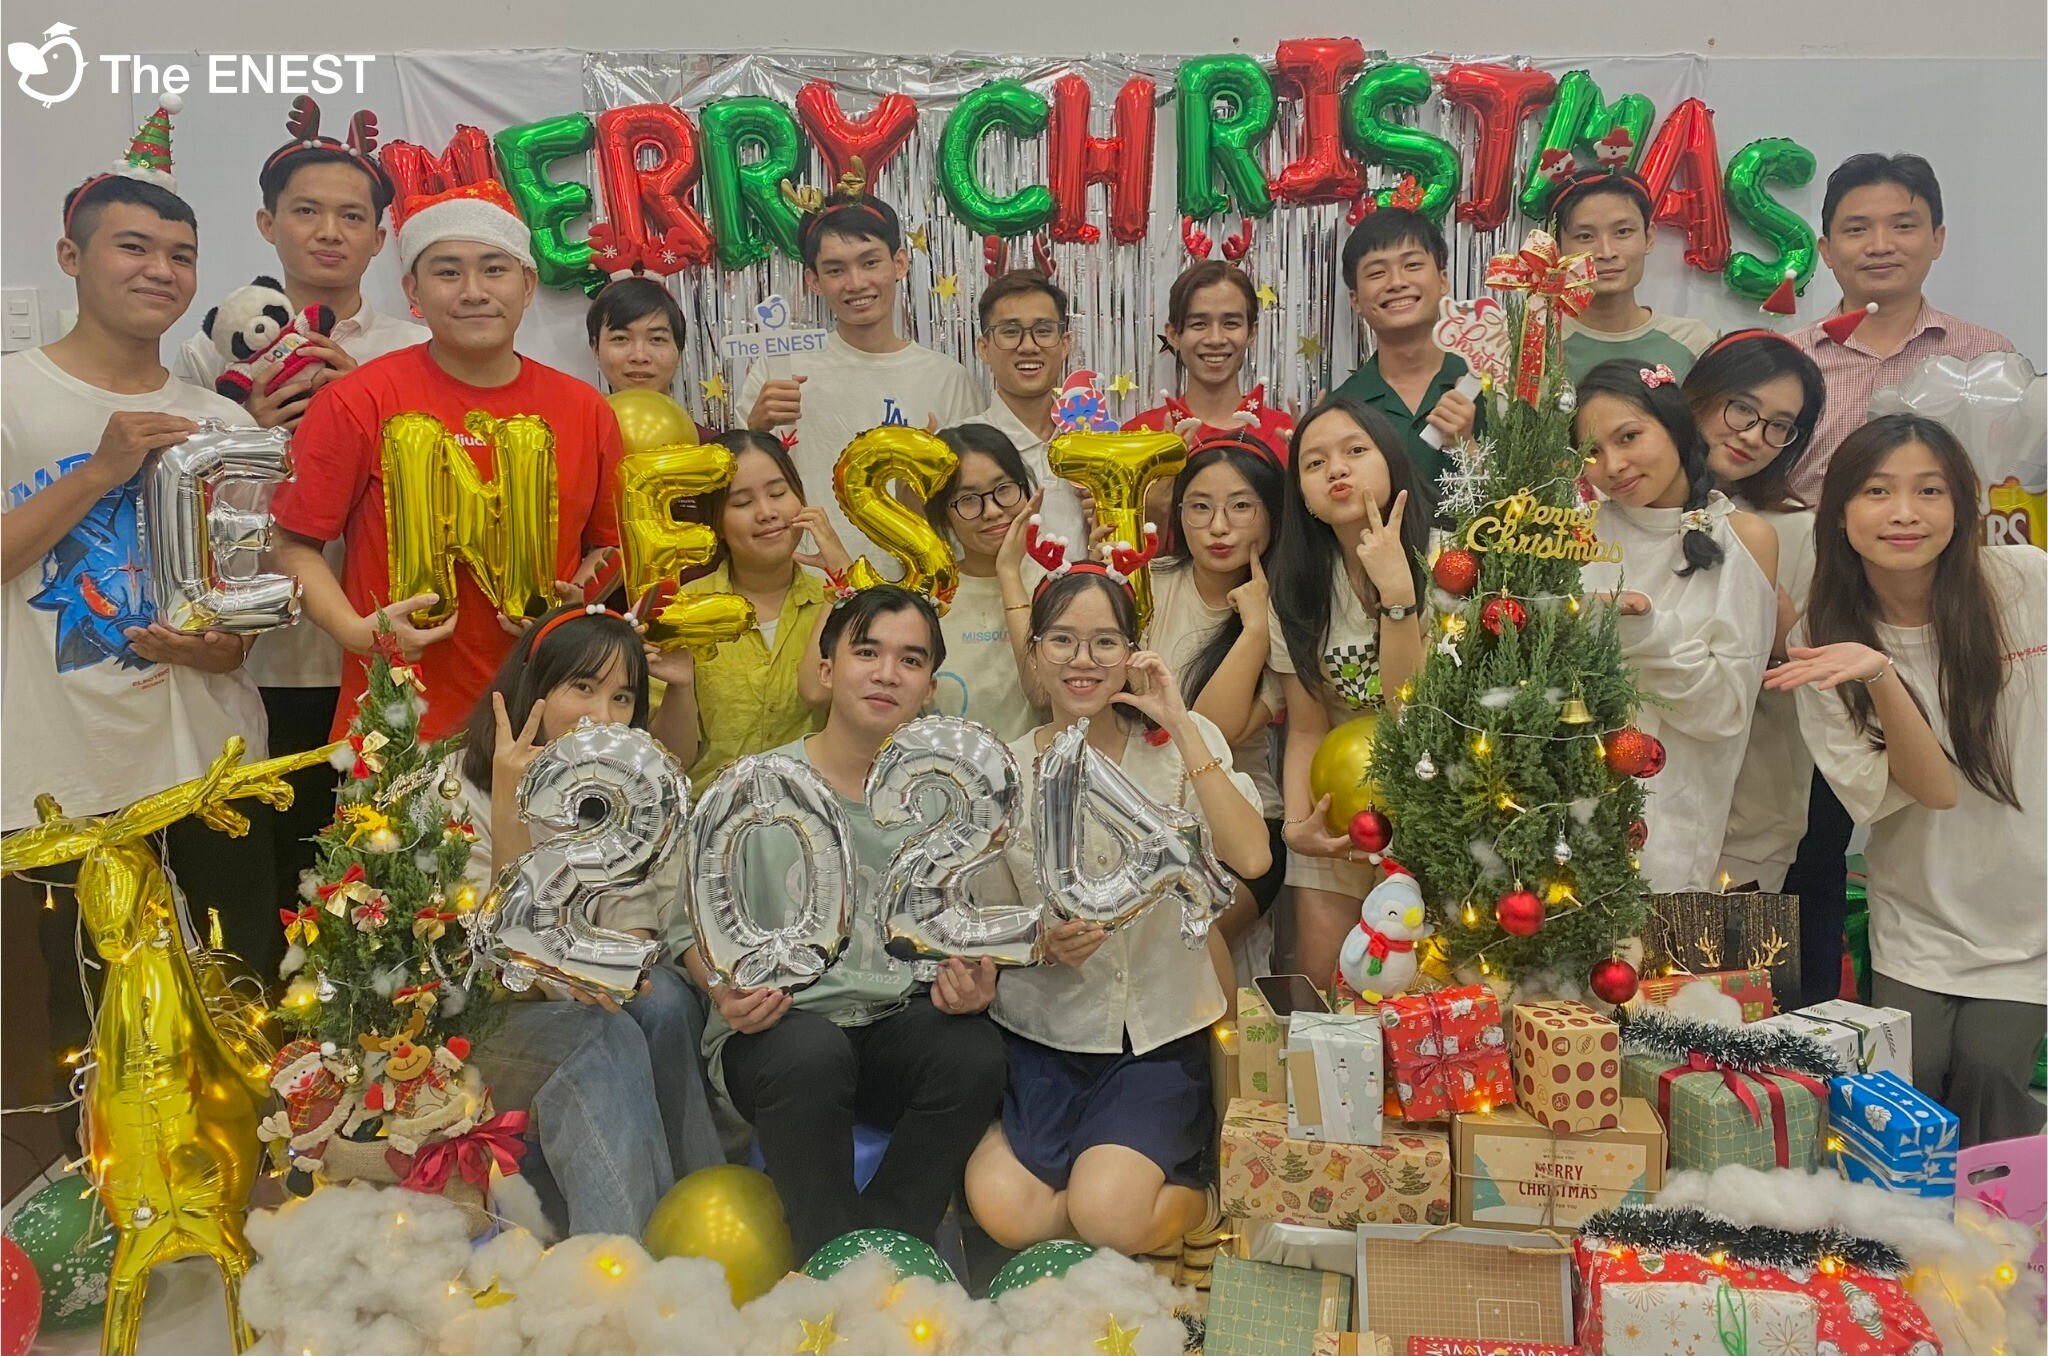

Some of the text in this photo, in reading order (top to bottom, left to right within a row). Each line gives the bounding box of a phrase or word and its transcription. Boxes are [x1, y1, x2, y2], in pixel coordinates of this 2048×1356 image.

[379, 36, 1820, 318] MERRY CHRISTMAS
[725, 333, 826, 356] The ENEST
[1437, 301, 1507, 384] Christ
[146, 412, 1187, 662] ENEST
[1467, 516, 1624, 564] Christmas
[1495, 493, 1600, 540] Merry
[962, 631, 1009, 641] MISSOU
[485, 714, 1238, 1000] 2024
[1534, 1162, 1583, 1180] MERRY
[66, 1256, 98, 1266] Merry
